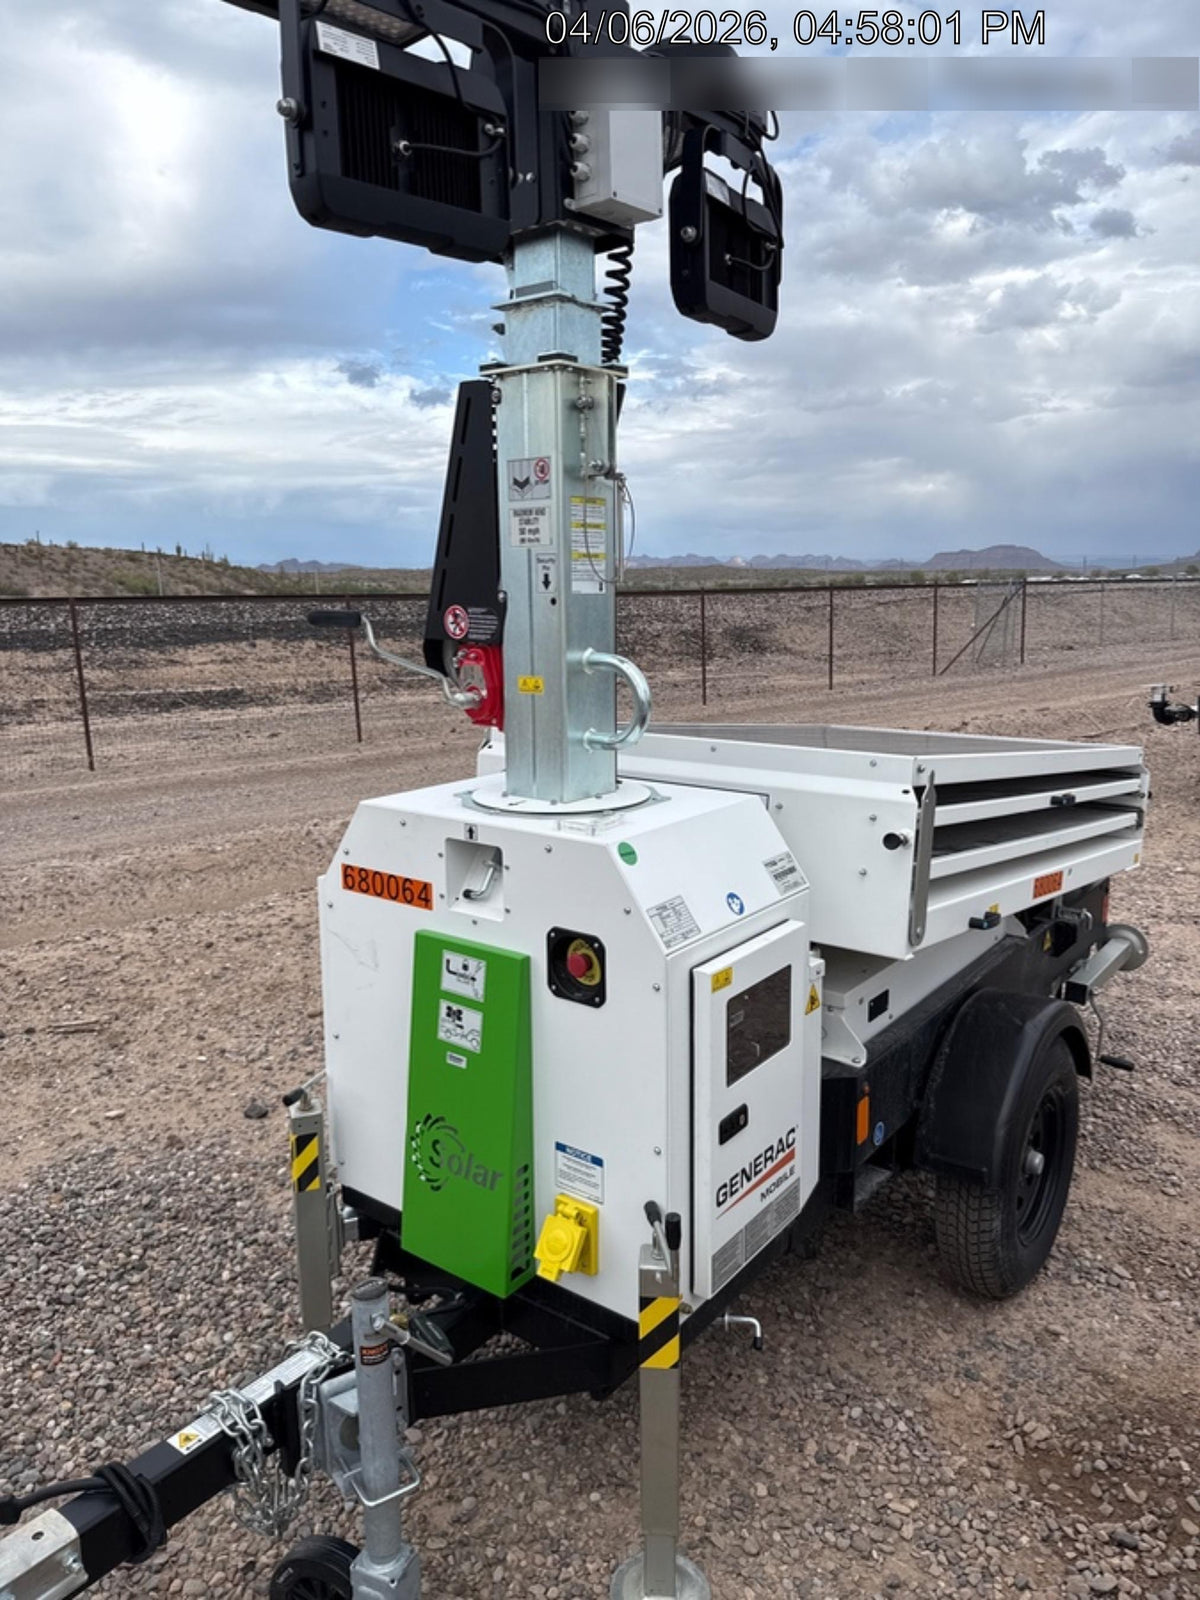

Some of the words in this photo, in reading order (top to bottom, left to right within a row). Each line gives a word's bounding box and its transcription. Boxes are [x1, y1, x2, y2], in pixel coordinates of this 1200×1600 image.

[343, 865, 432, 908] 680064
[429, 1139, 503, 1191] Solar
[716, 1127, 796, 1208] GENERAC
[760, 1165, 796, 1202] MOBILE
